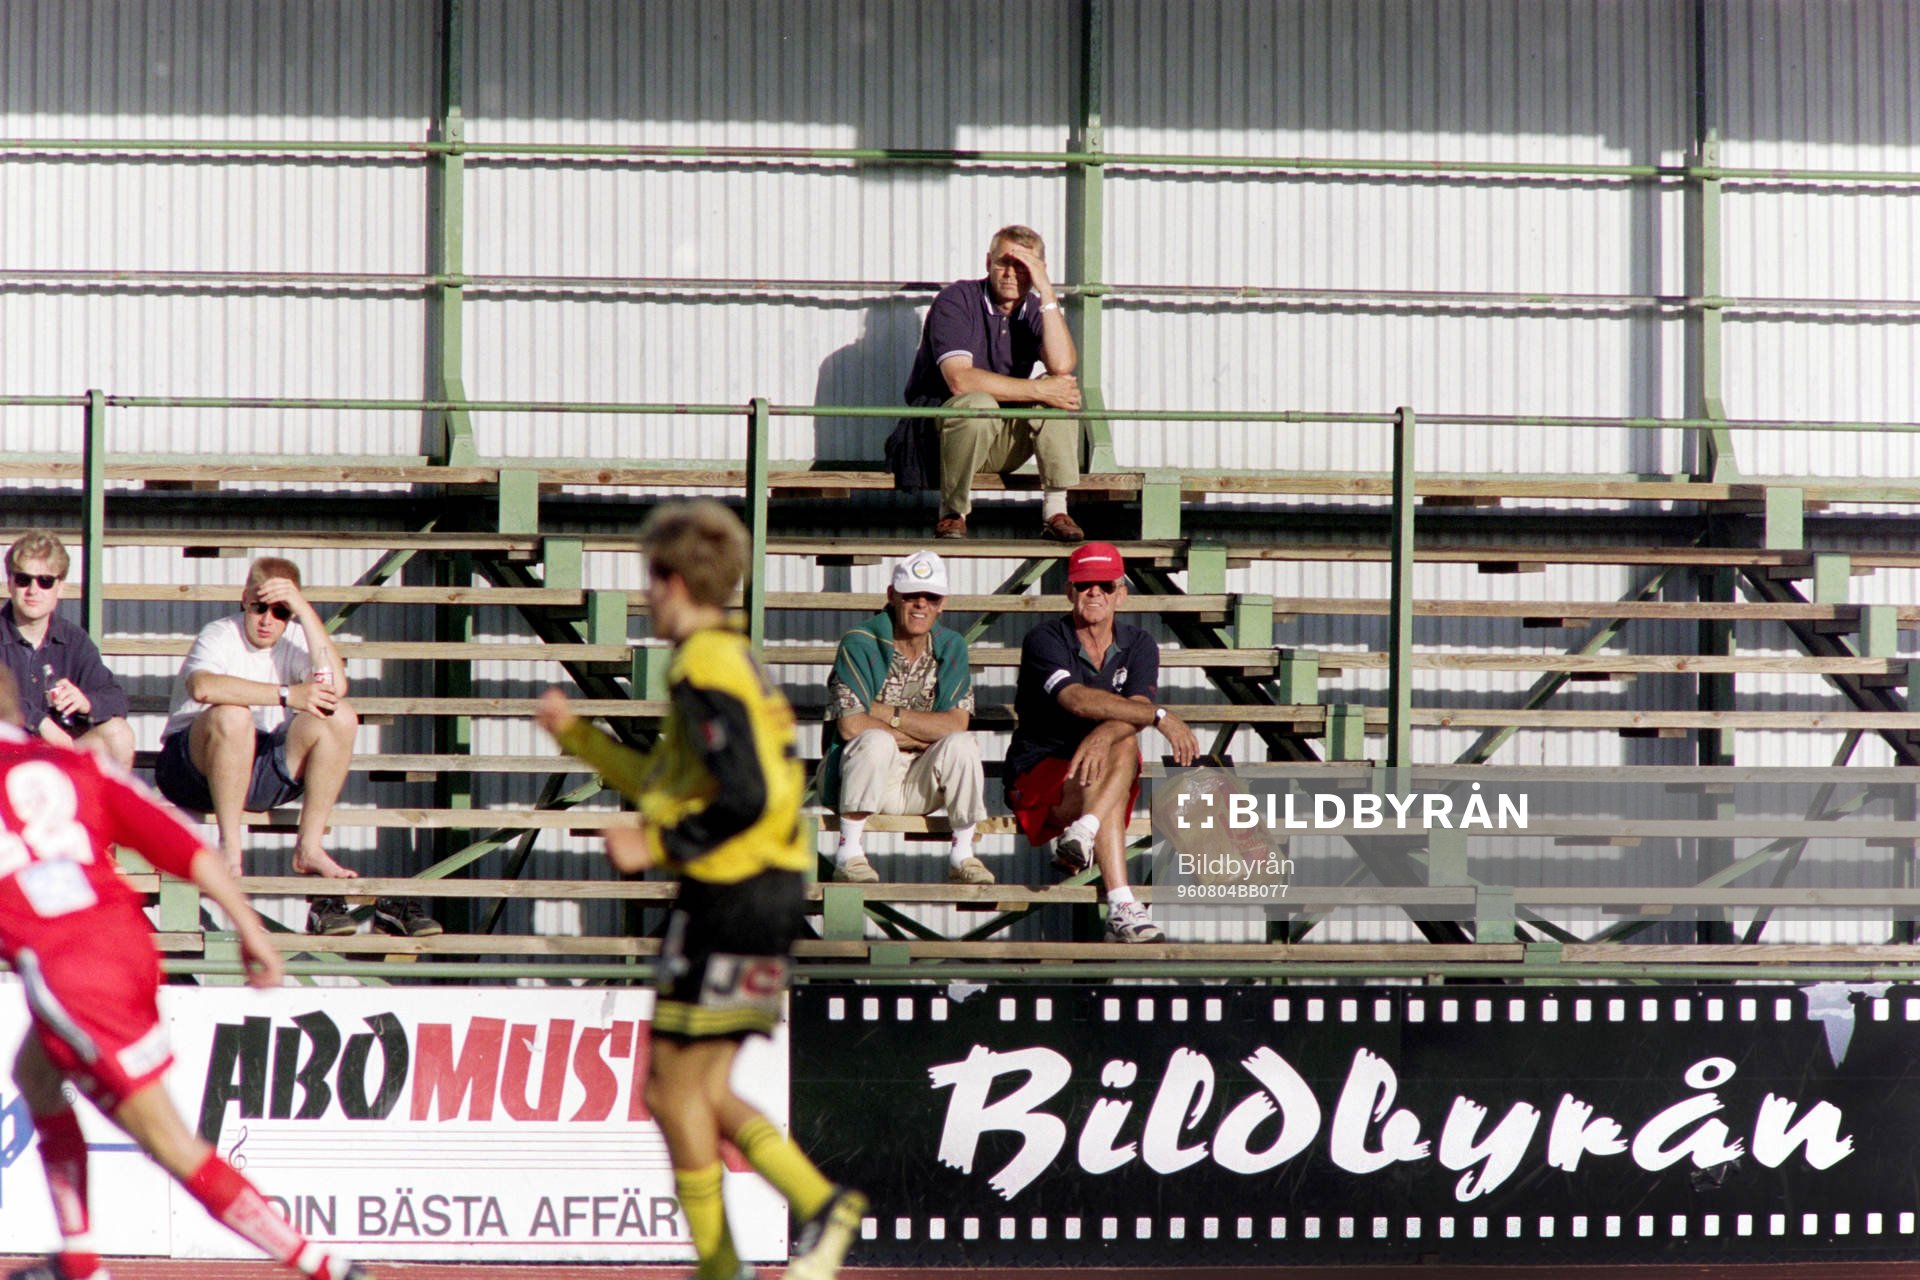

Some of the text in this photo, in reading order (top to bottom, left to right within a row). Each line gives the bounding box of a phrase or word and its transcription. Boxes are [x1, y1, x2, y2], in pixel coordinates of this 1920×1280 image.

[195, 1010, 655, 1152] ABOMUSI
[928, 1045, 1855, 1202] Bildbyrån
[358, 1187, 509, 1237] BÄSTA
